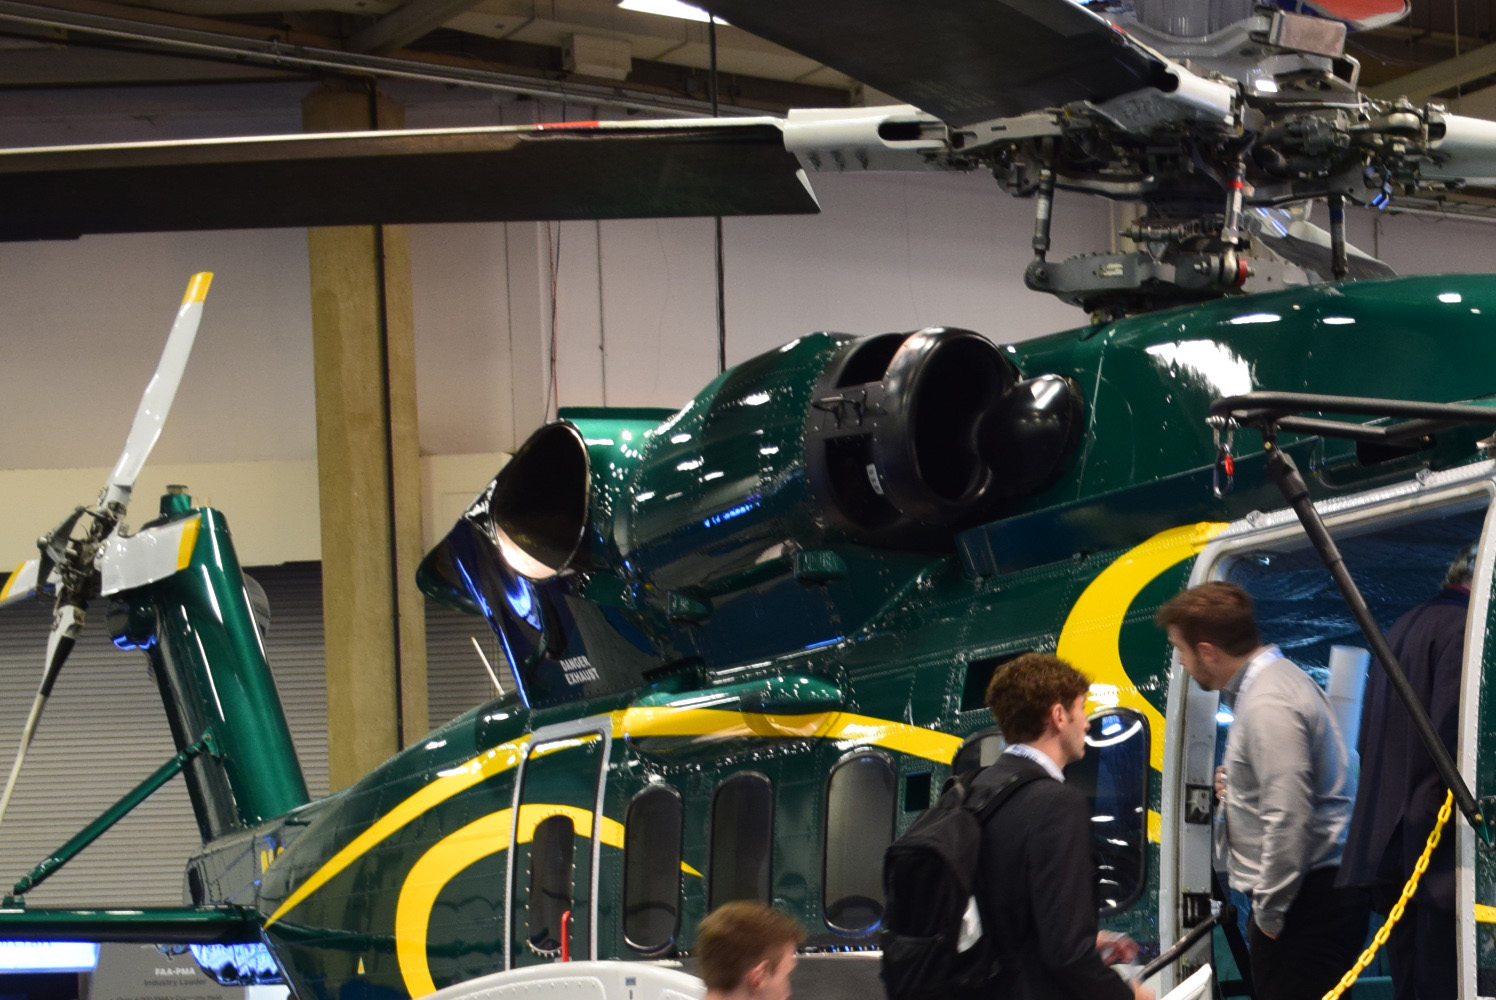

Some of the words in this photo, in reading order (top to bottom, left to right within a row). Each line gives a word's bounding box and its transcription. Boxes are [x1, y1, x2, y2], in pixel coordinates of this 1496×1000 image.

[560, 655, 591, 671] DANGER
[565, 667, 600, 685] EXHAUST
[155, 967, 196, 976] FAA-PMA
